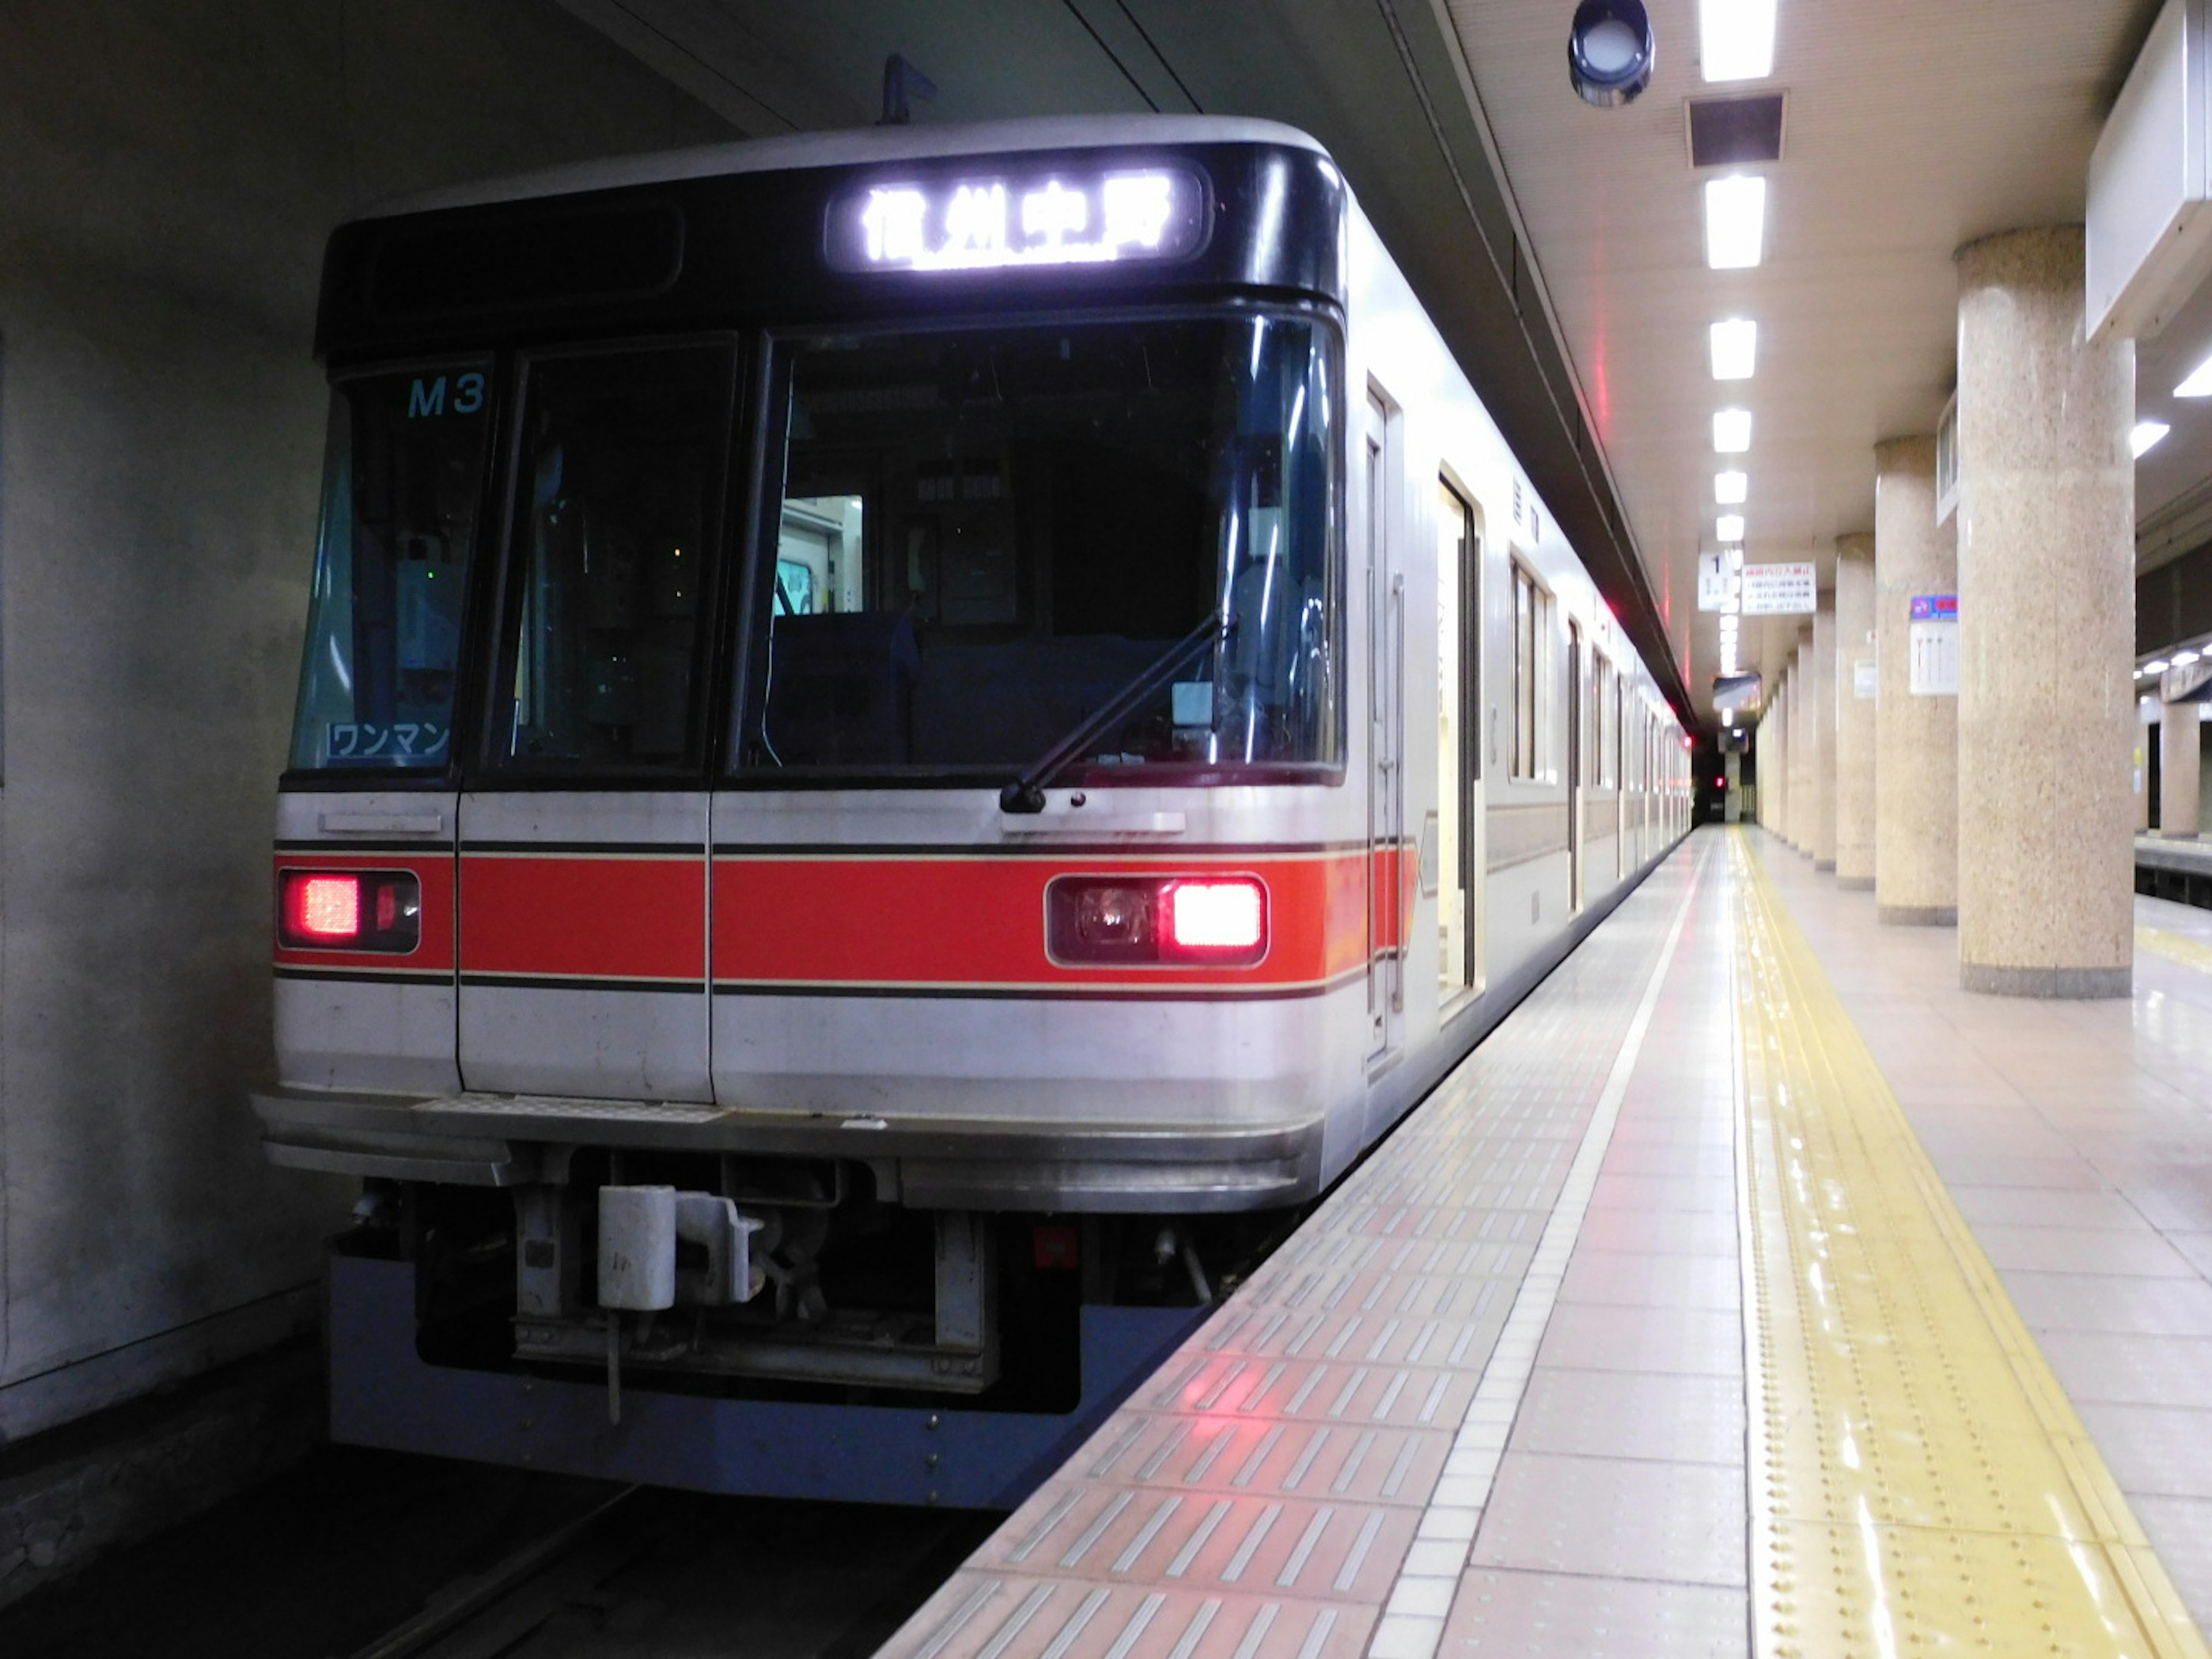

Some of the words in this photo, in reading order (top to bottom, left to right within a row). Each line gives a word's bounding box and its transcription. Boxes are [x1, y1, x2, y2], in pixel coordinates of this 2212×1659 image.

[407, 373, 485, 418] M3
[334, 723, 449, 756] ワンマン
